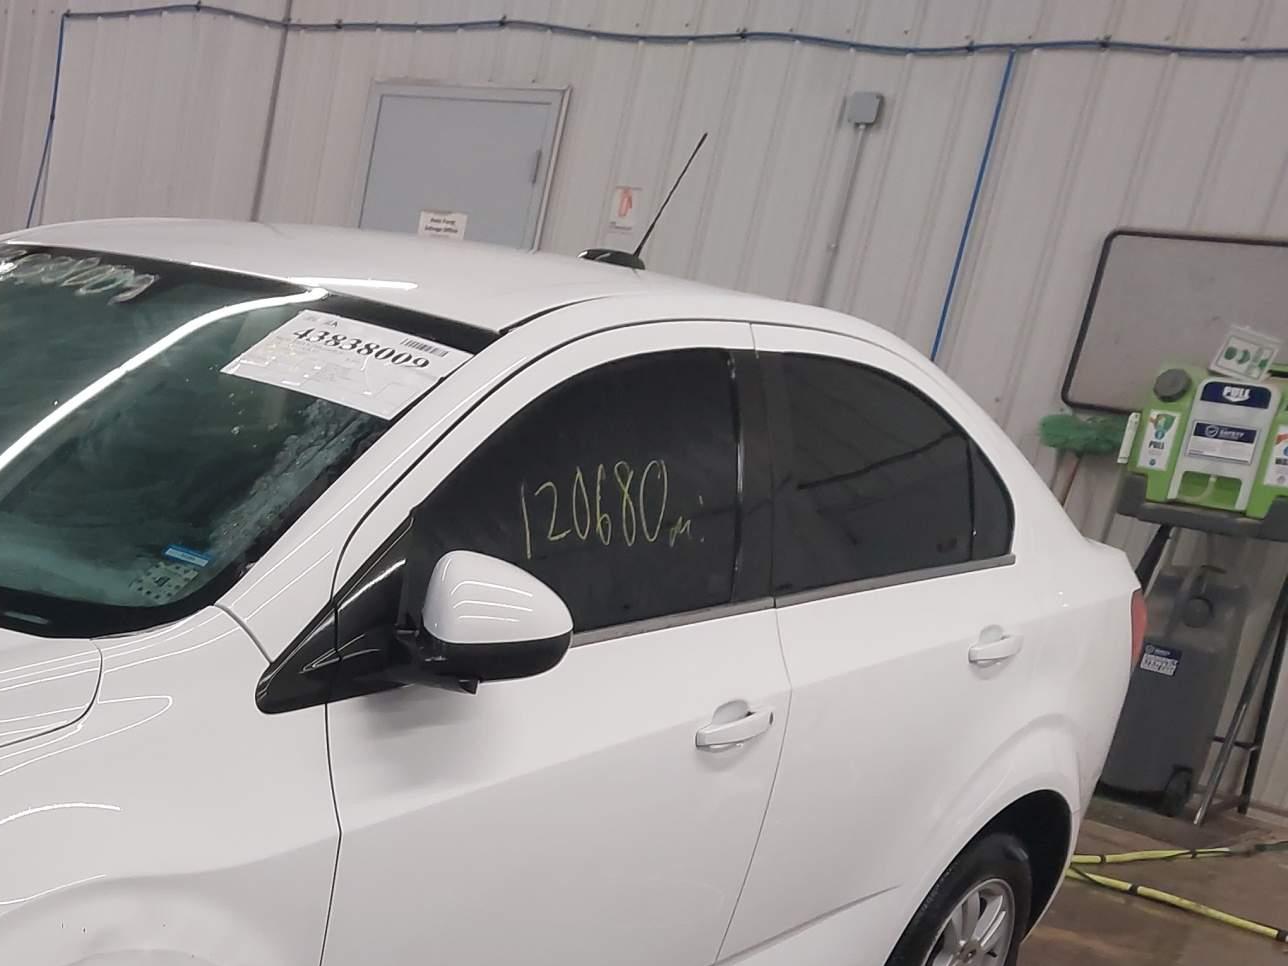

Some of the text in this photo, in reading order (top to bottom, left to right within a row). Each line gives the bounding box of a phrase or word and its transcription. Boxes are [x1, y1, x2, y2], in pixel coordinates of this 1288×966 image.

[293, 327, 431, 370] 43838009
[1223, 385, 1251, 400] PULL
[521, 459, 668, 560] 120680
